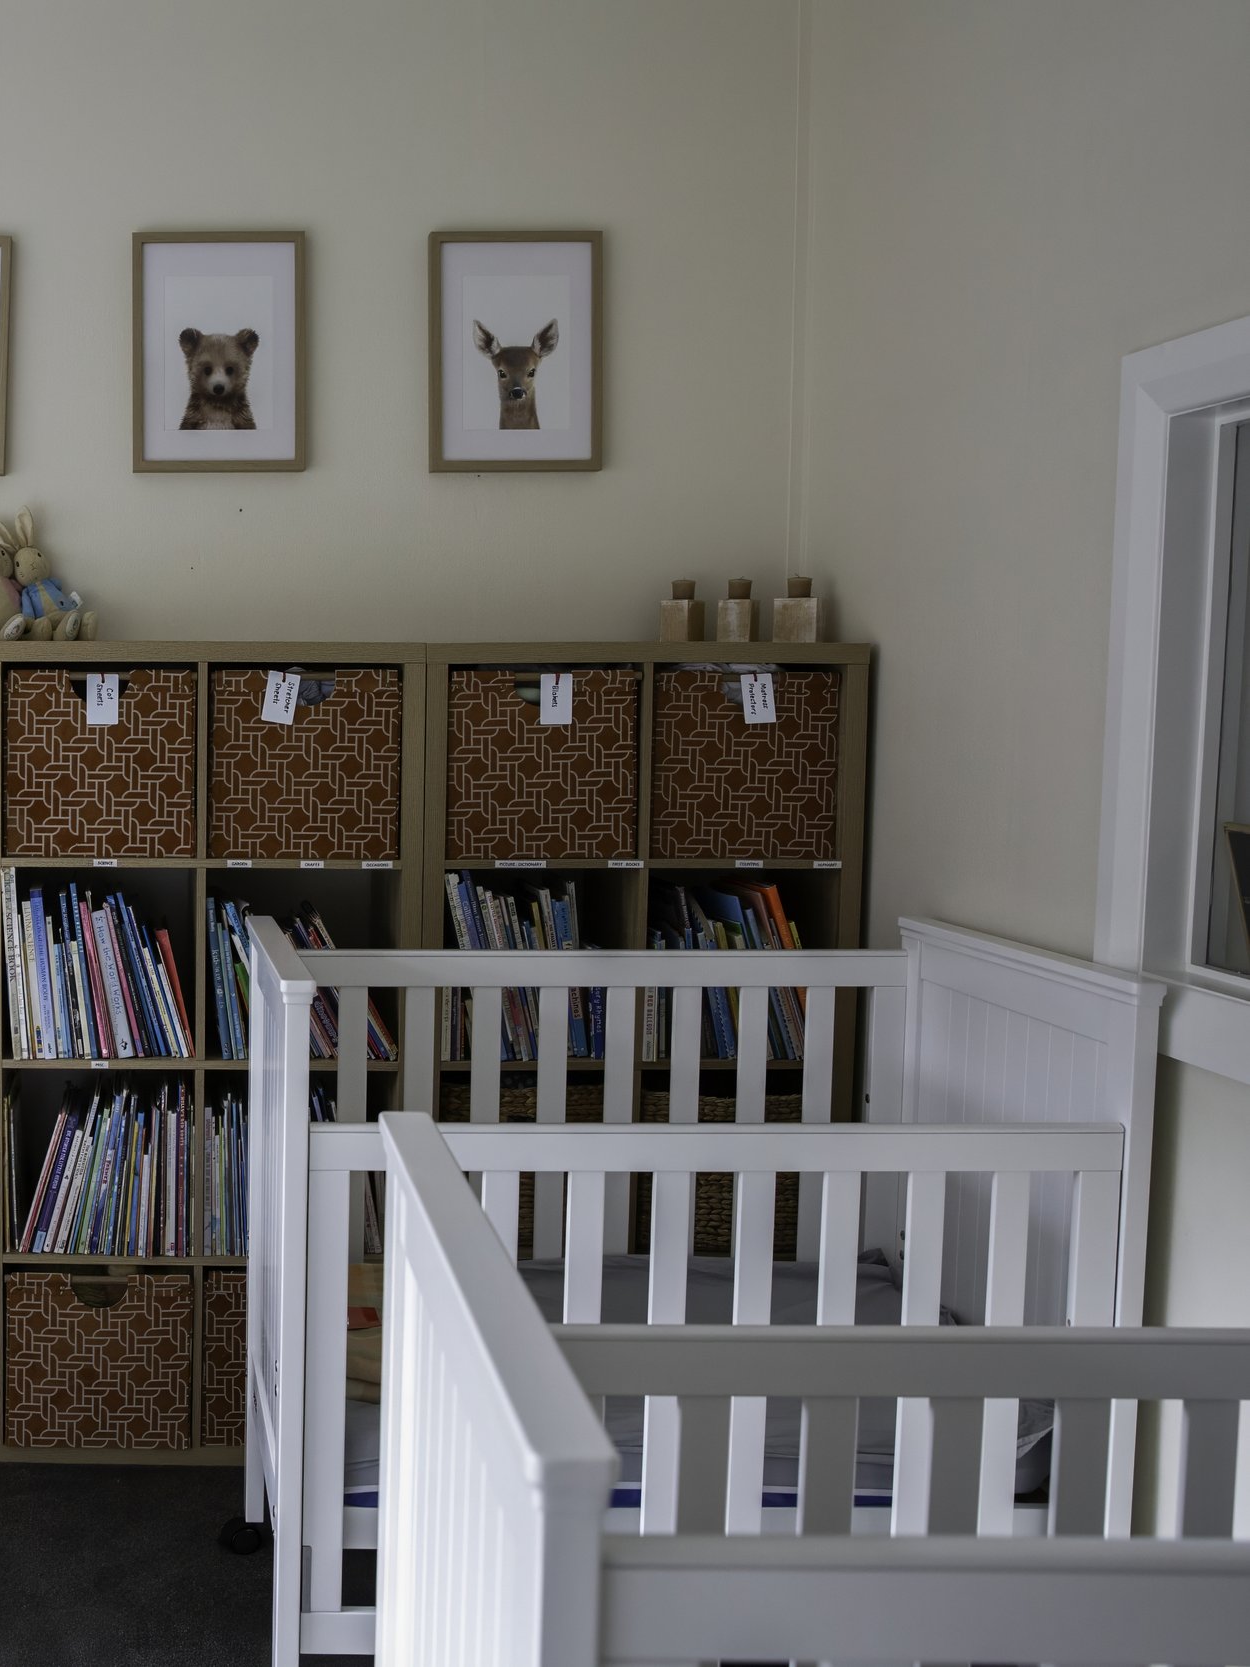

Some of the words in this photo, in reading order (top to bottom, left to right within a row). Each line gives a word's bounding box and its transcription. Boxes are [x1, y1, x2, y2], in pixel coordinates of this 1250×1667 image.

[283, 682, 295, 713] Stretcher
[748, 683, 757, 715] Protectors
[6, 913, 14, 952] SCIENCE
[98, 926, 107, 944] How
[103, 948, 111, 961] the
[107, 962, 118, 987] World
[112, 990, 122, 1015] Works
